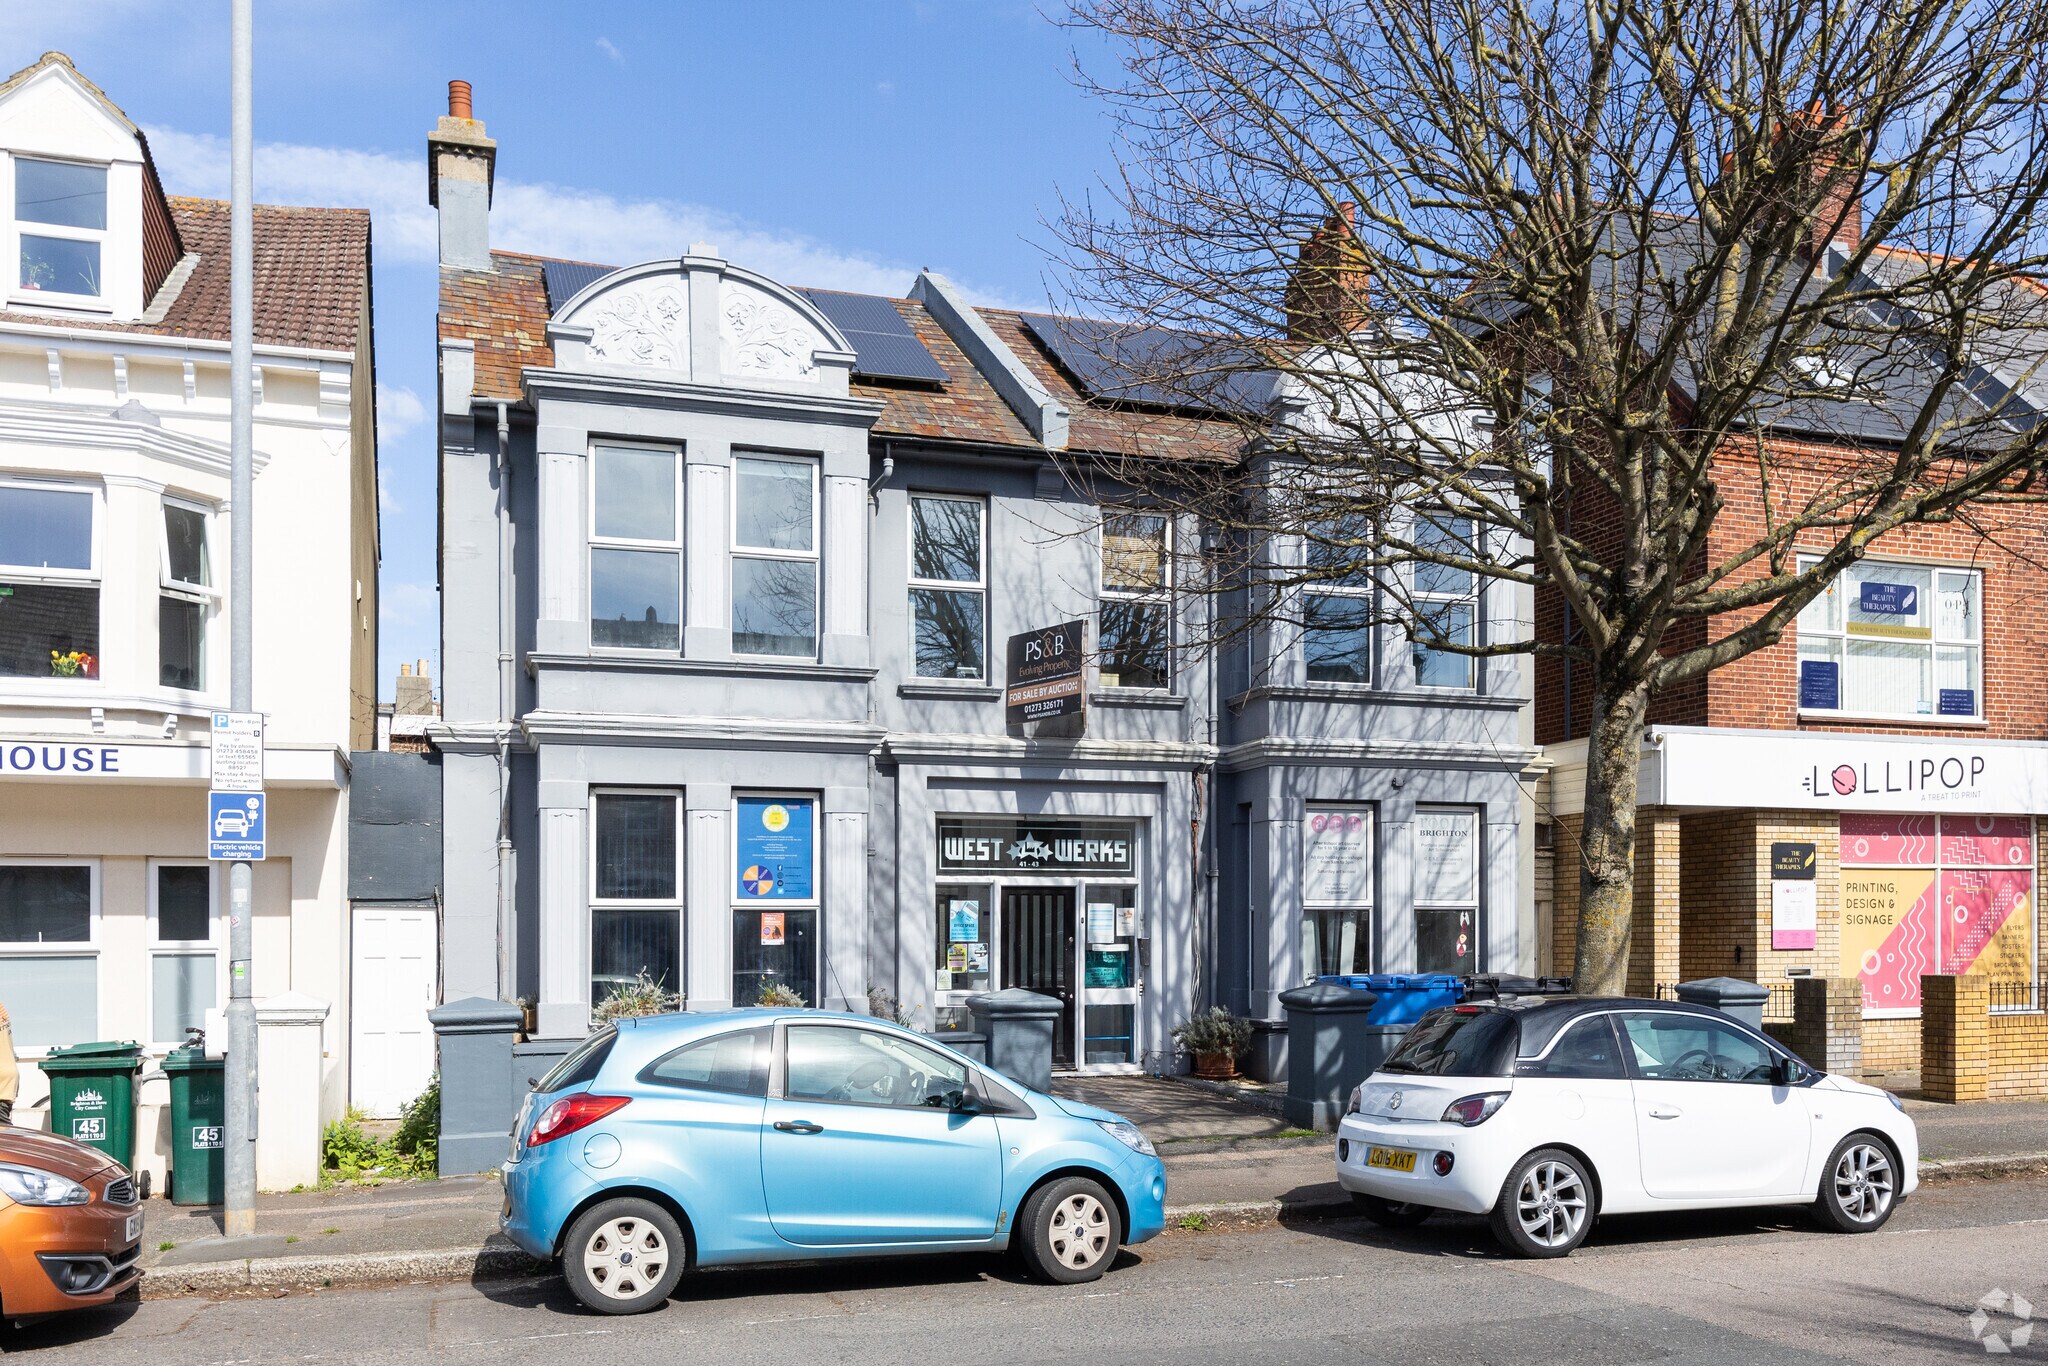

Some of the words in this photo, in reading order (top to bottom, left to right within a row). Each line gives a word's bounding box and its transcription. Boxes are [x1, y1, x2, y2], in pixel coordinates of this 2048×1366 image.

[1862, 602, 1896, 611] THERAPIES
[1019, 665, 1042, 676] Evolving
[1044, 660, 1070, 673] Property
[1010, 693, 1022, 702] FOR
[1023, 689, 1038, 699] SALE
[1039, 687, 1048, 697] BY
[1049, 681, 1078, 695] AUCTION
[1024, 704, 1042, 713] 01273
[1043, 699, 1063, 710] 326171
[0, 746, 119, 772] OUSE
[1814, 756, 1985, 797] LOLLIPOP
[1961, 791, 1981, 799] PRINT
[945, 837, 1004, 860] WEST
[1054, 839, 1127, 862] WERKS
[1846, 883, 1898, 895] PRINTING,
[1846, 898, 1885, 908] DESIGN
[1889, 899, 1895, 908] &
[1846, 914, 1893, 925] SIGNAGE
[79, 1120, 100, 1133] 45
[199, 1129, 218, 1141] 45
[1392, 1152, 1412, 1168] XKT
